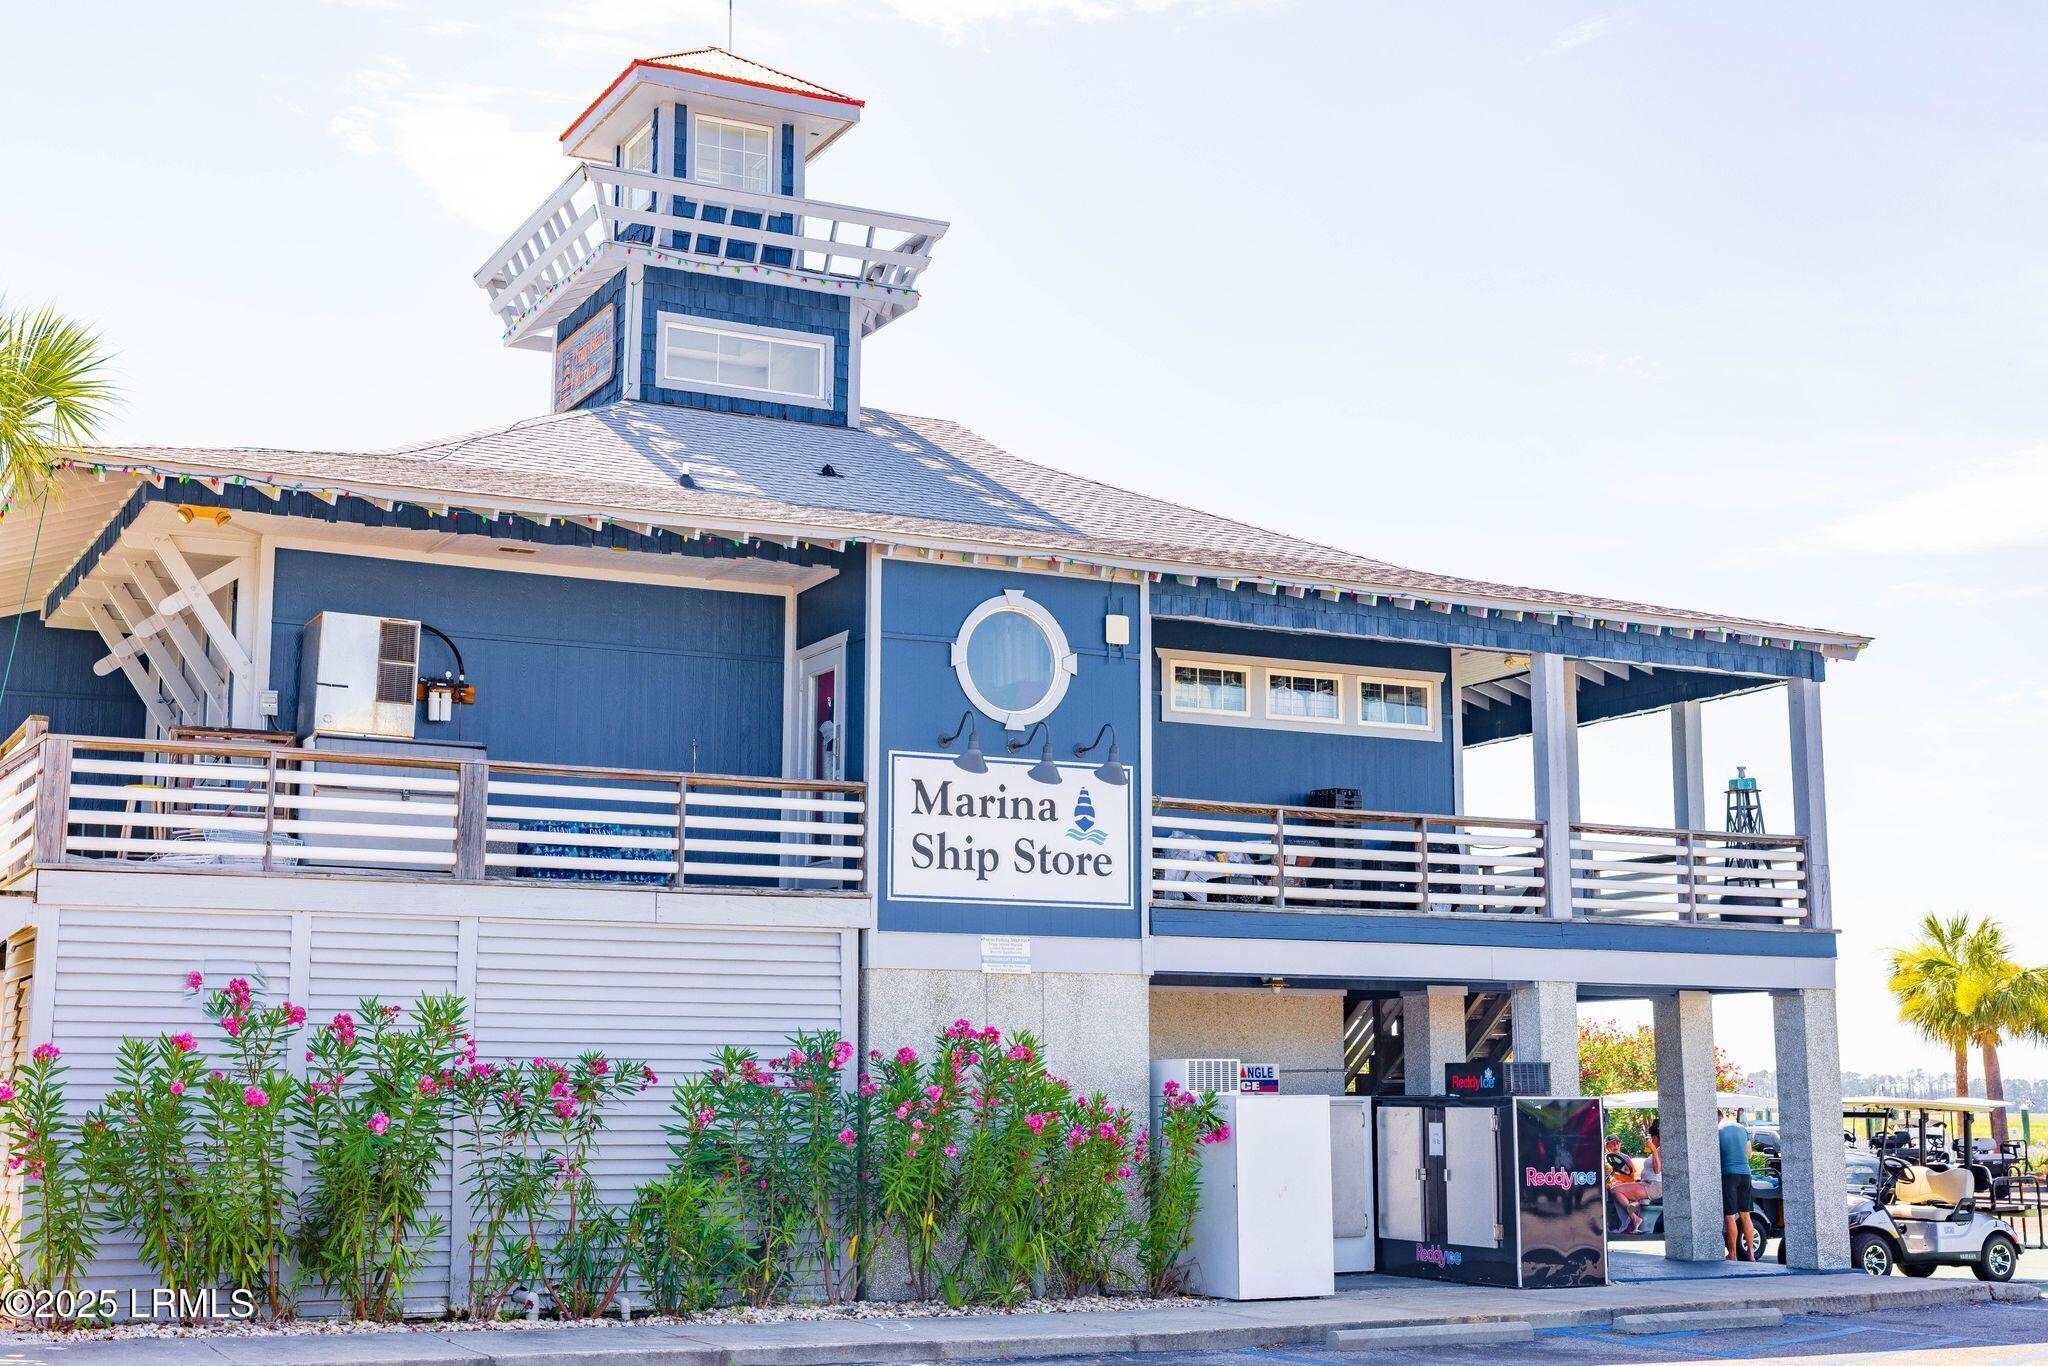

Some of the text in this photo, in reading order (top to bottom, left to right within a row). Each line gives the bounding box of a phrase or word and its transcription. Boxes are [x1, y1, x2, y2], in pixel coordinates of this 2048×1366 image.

[911, 778, 1059, 822] Marina
[911, 832, 1113, 881] Ship Store
[1240, 1066, 1275, 1079] ANGLE
[1240, 1081, 1261, 1091] CE
